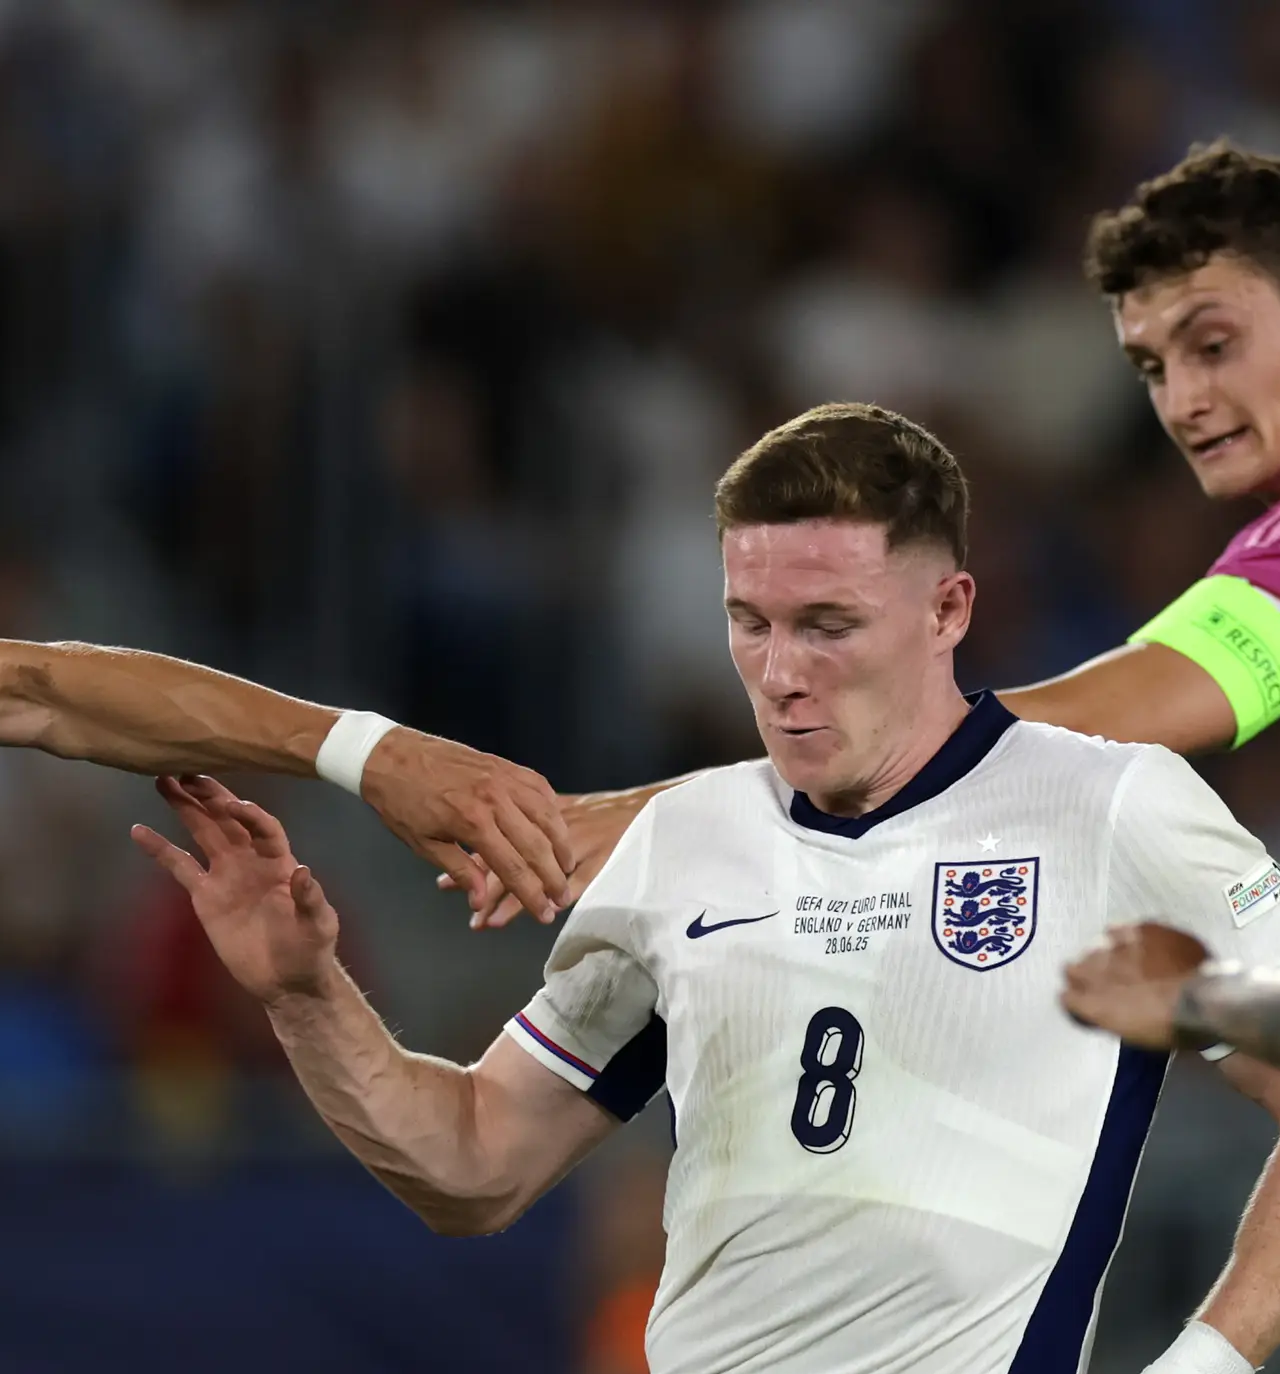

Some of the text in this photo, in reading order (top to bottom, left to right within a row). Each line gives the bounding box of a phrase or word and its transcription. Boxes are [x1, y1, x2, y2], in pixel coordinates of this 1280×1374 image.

[795, 891, 913, 915] UEFA U21 EURO FINAL
[793, 916, 842, 934] ENGLAND
[857, 913, 912, 933] GERMANY
[824, 936, 870, 955] 28.06.25
[790, 1005, 865, 1155] 8
